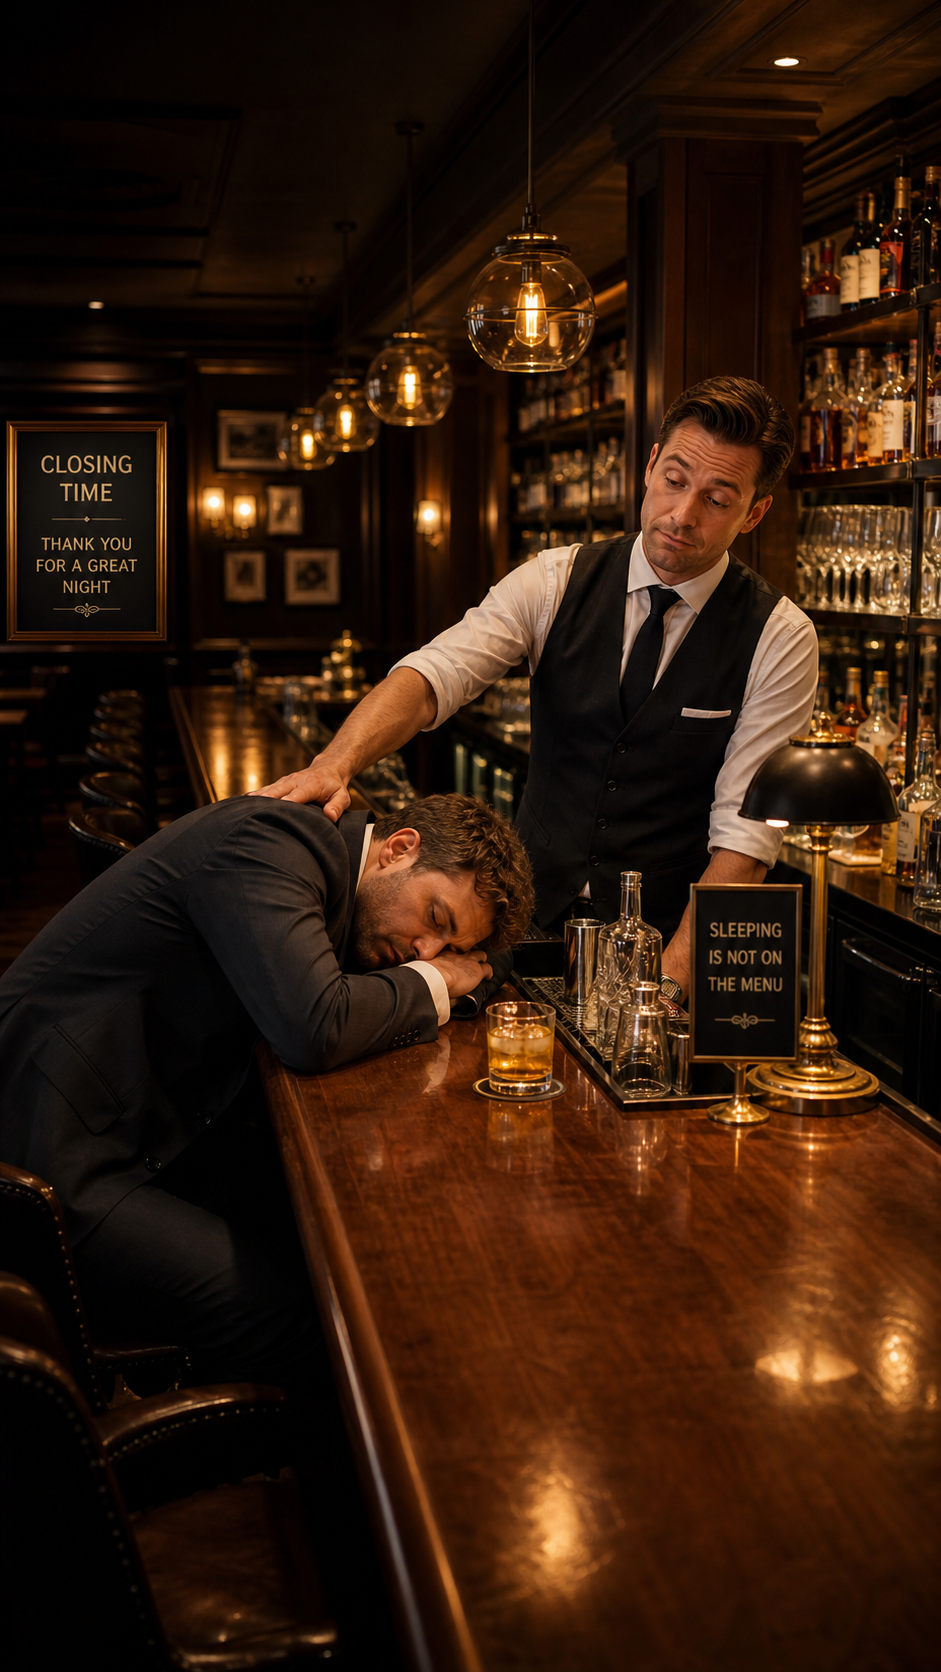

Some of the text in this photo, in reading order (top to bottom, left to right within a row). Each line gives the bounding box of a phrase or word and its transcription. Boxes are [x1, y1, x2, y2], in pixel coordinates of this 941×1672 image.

[41, 454, 132, 474] CLOSING
[59, 483, 113, 502] TIME
[41, 537, 132, 551] THANK YOU
[36, 558, 138, 573] FOR A GREAT
[63, 580, 111, 594] NIGHT
[709, 922, 783, 938] SLEEPING
[709, 949, 783, 965] IS NOT ON
[708, 976, 783, 992] THE MENU
